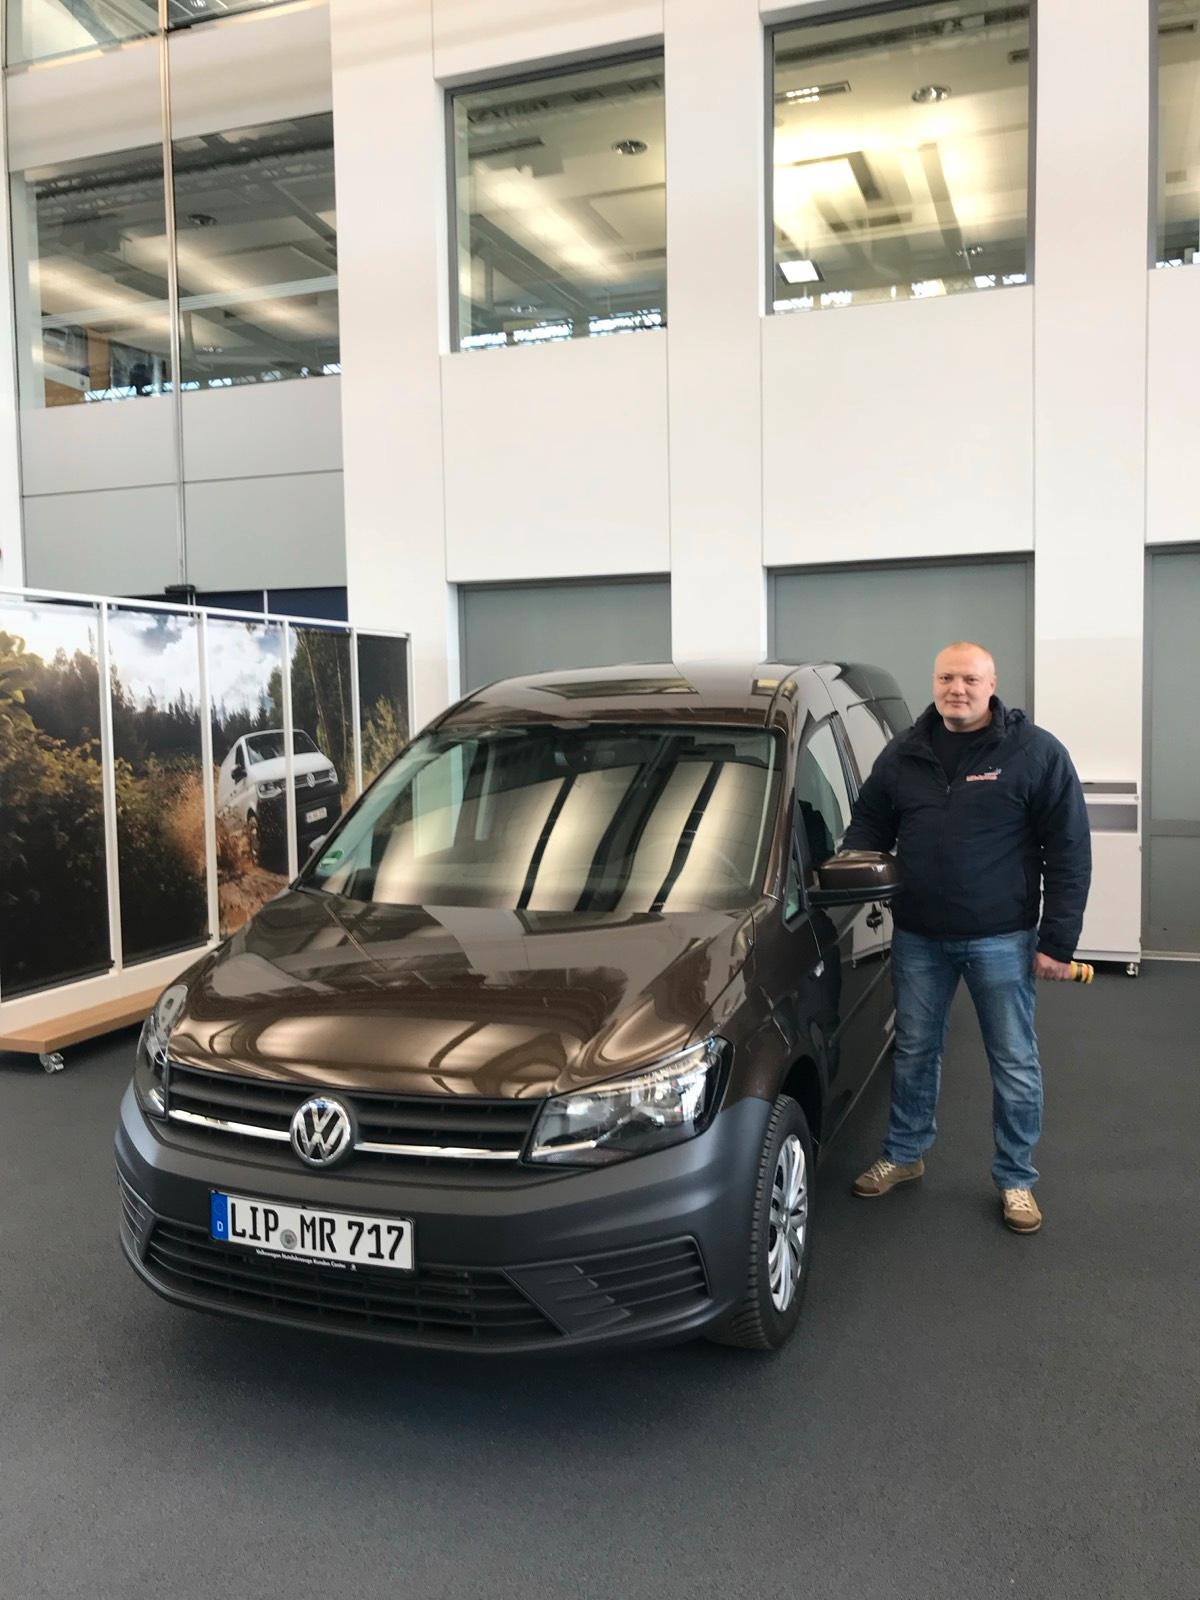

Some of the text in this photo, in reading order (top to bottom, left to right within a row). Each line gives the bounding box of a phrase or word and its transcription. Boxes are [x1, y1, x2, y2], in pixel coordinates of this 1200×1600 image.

[216, 1220, 224, 1232] D
[231, 1202, 404, 1261] LIP MR 717
